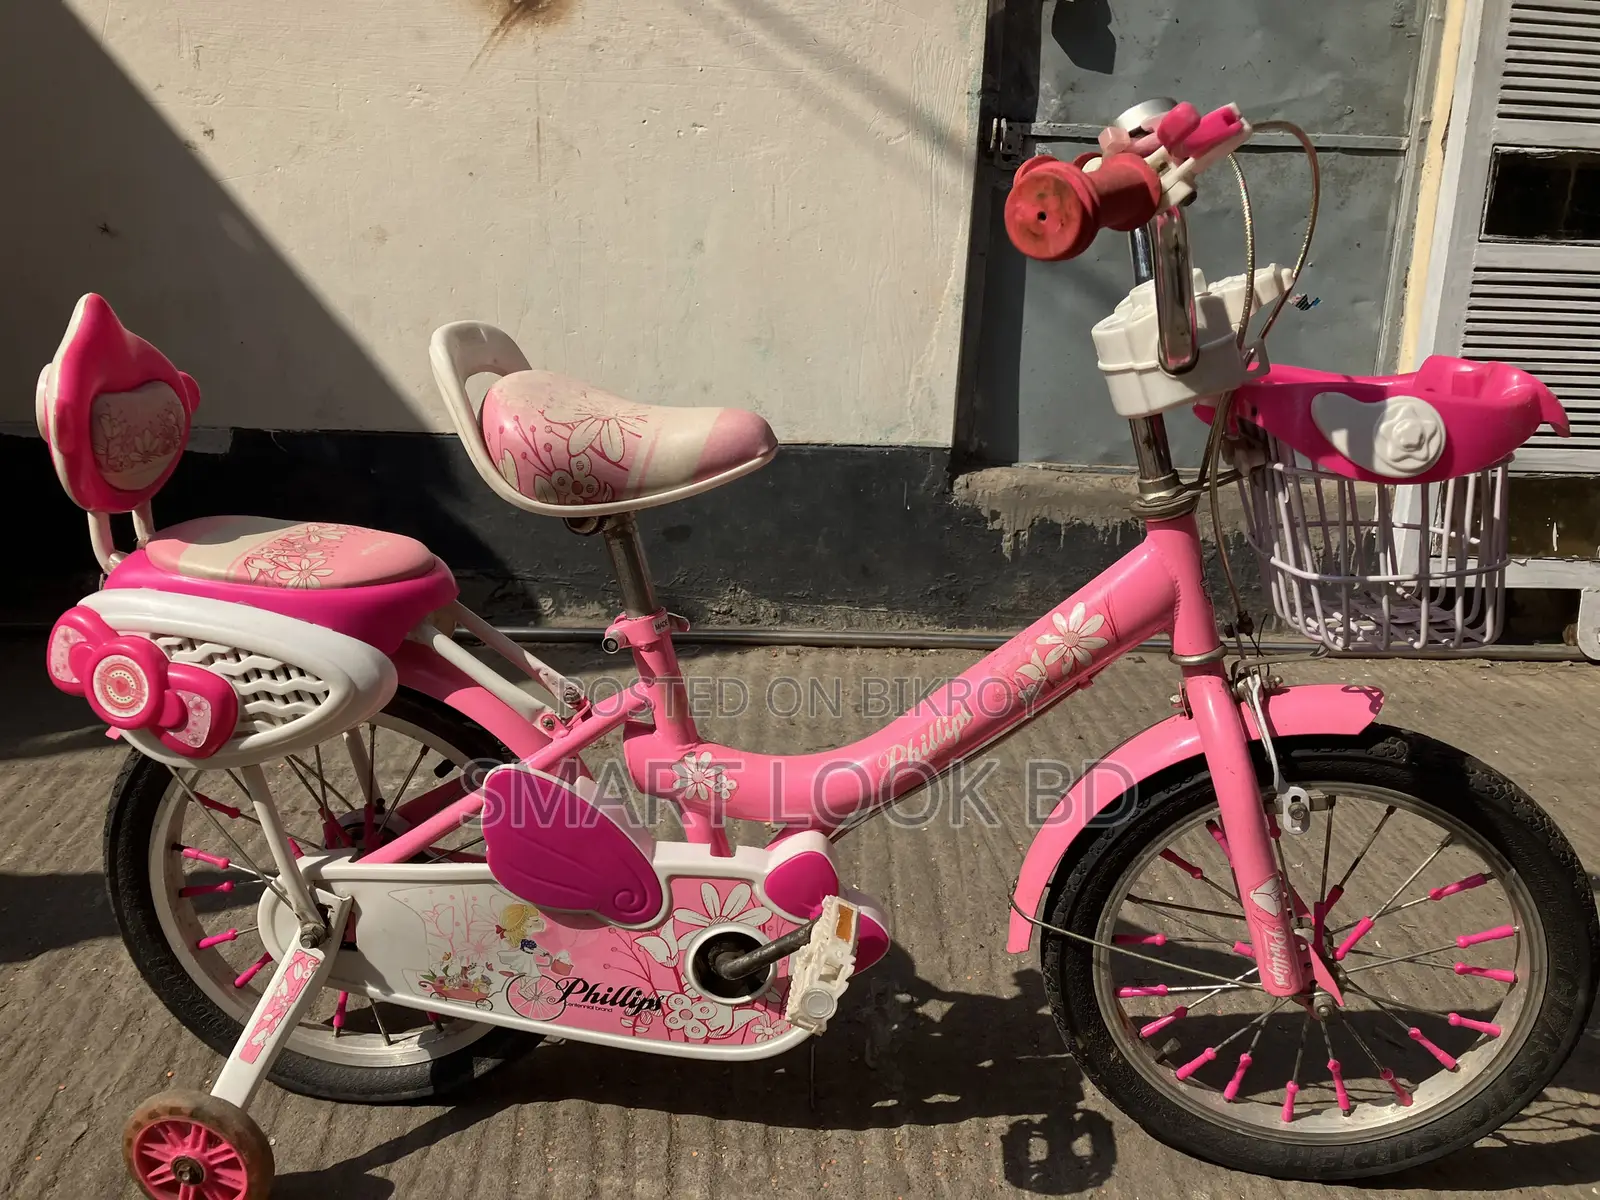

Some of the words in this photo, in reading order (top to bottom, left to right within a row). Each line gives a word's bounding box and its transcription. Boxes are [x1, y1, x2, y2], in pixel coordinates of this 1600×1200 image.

[654, 618, 669, 631] MADE
[877, 705, 974, 784] Phillips
[1265, 925, 1292, 987] Phillips
[547, 976, 665, 1016] Phillips
